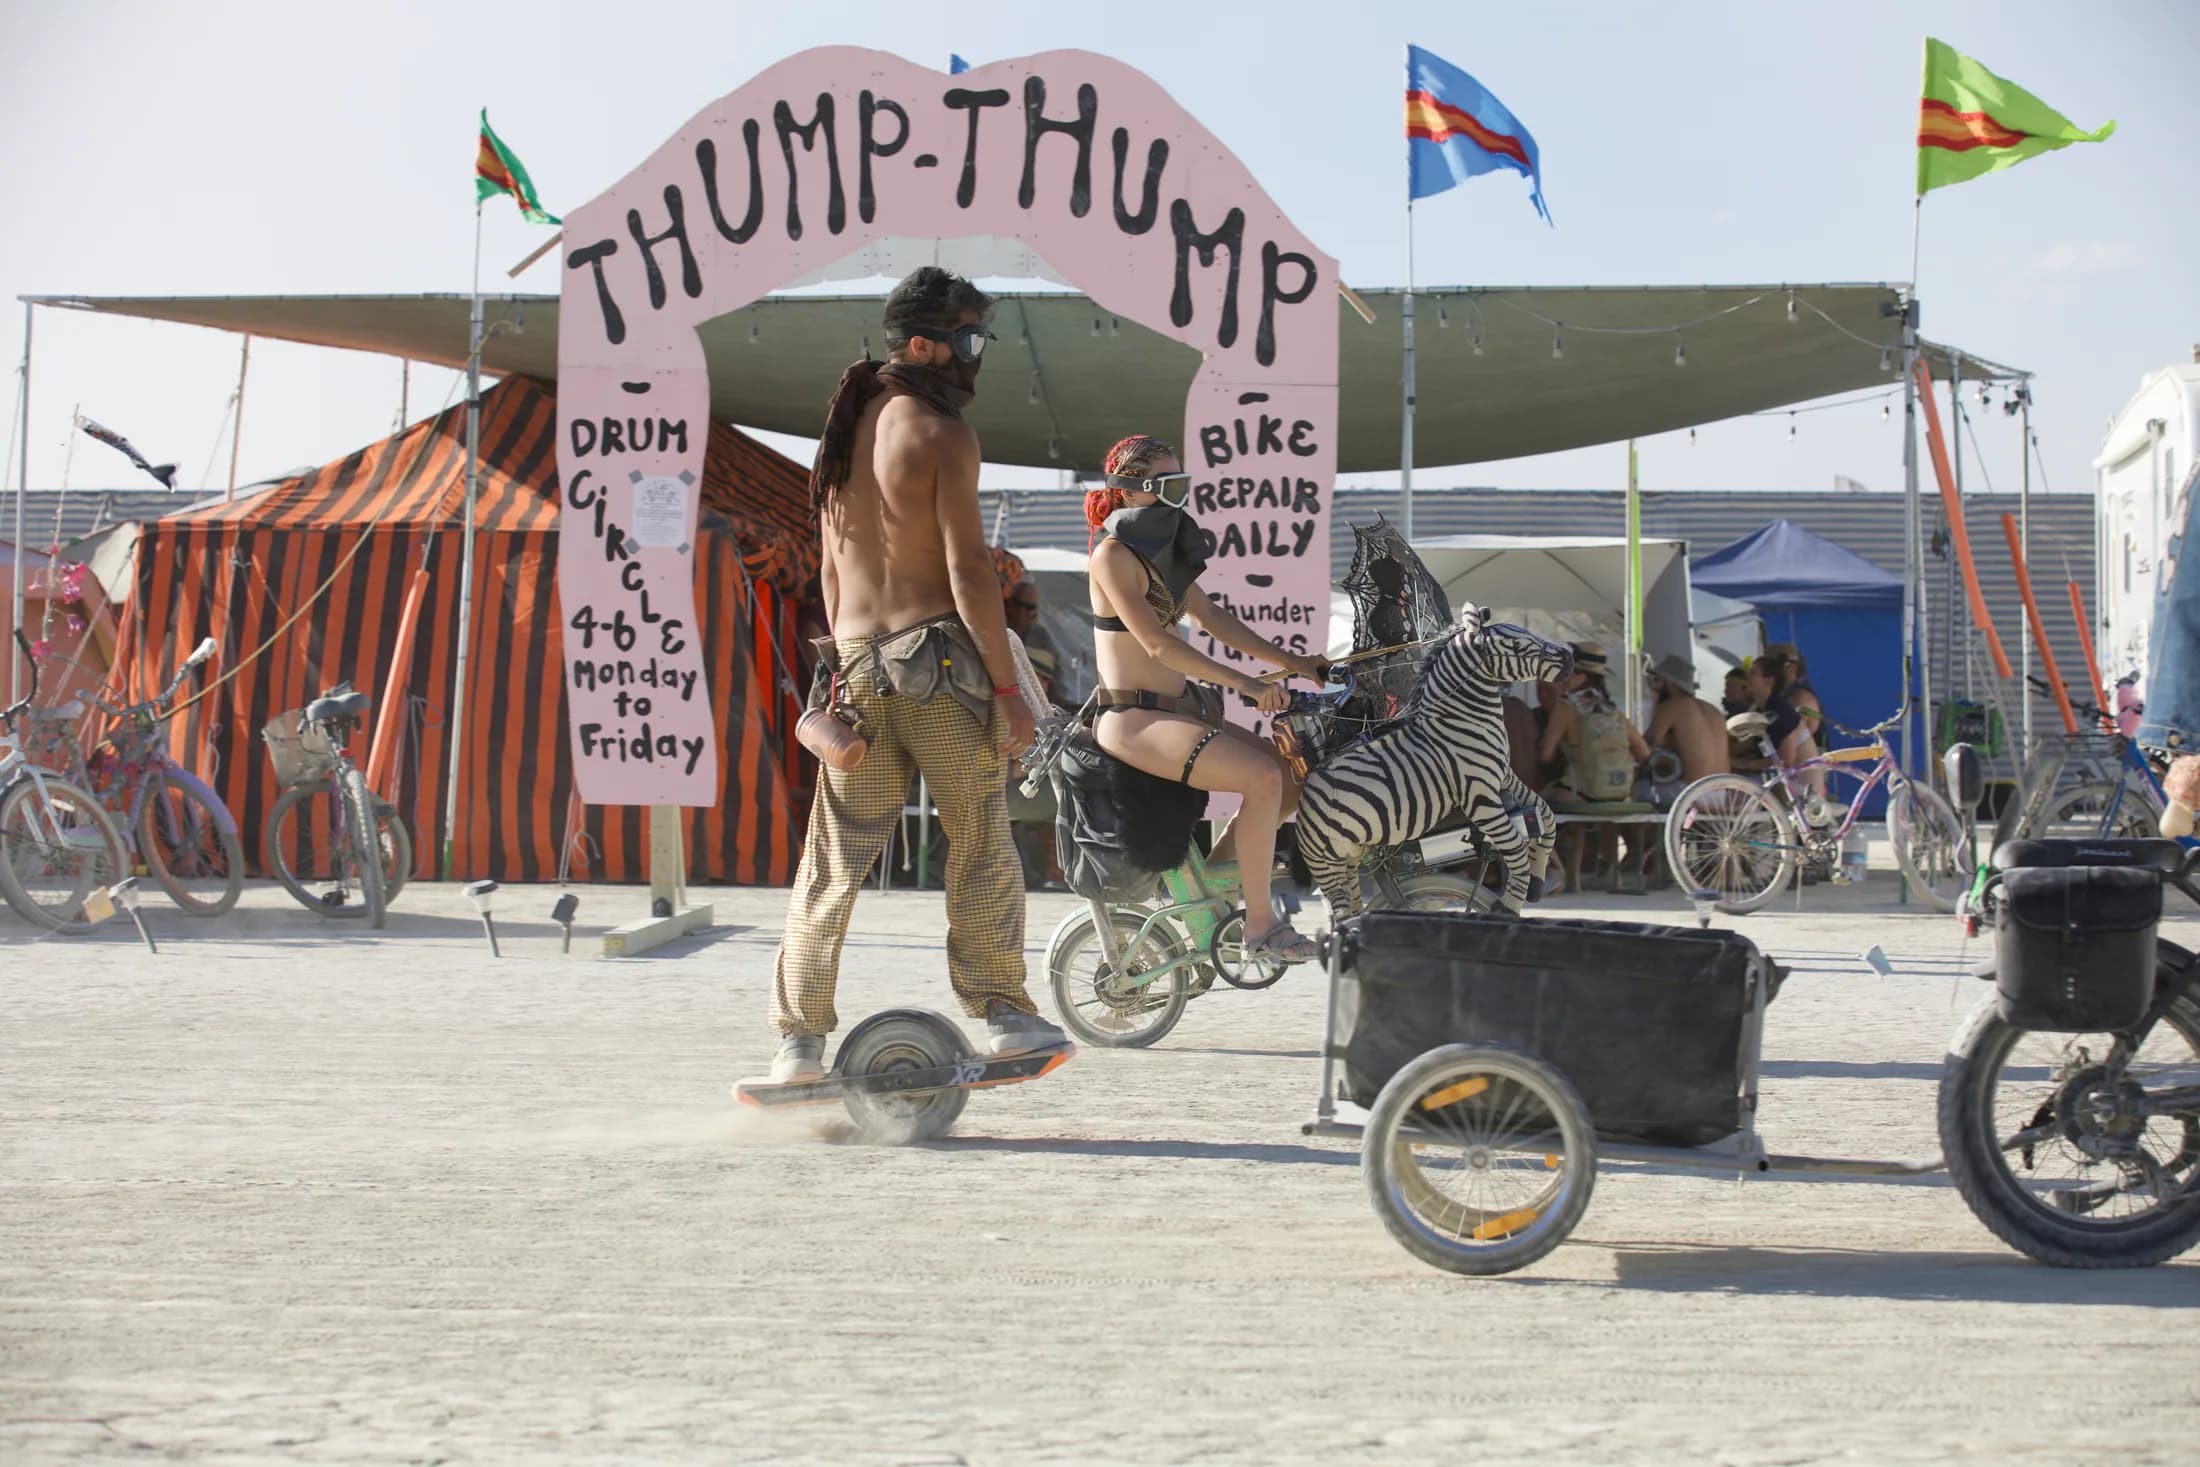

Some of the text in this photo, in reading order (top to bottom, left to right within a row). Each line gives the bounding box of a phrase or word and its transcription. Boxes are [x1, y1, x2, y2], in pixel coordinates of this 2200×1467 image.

[570, 416, 688, 458] DRUM
[1199, 414, 1318, 469] BIKE
[1193, 475, 1321, 516] REPAIR
[570, 604, 637, 653] 4-6
[573, 656, 698, 703] Monday
[613, 690, 653, 718] to
[578, 721, 705, 777] Friday
[950, 1063, 987, 1086] XR
